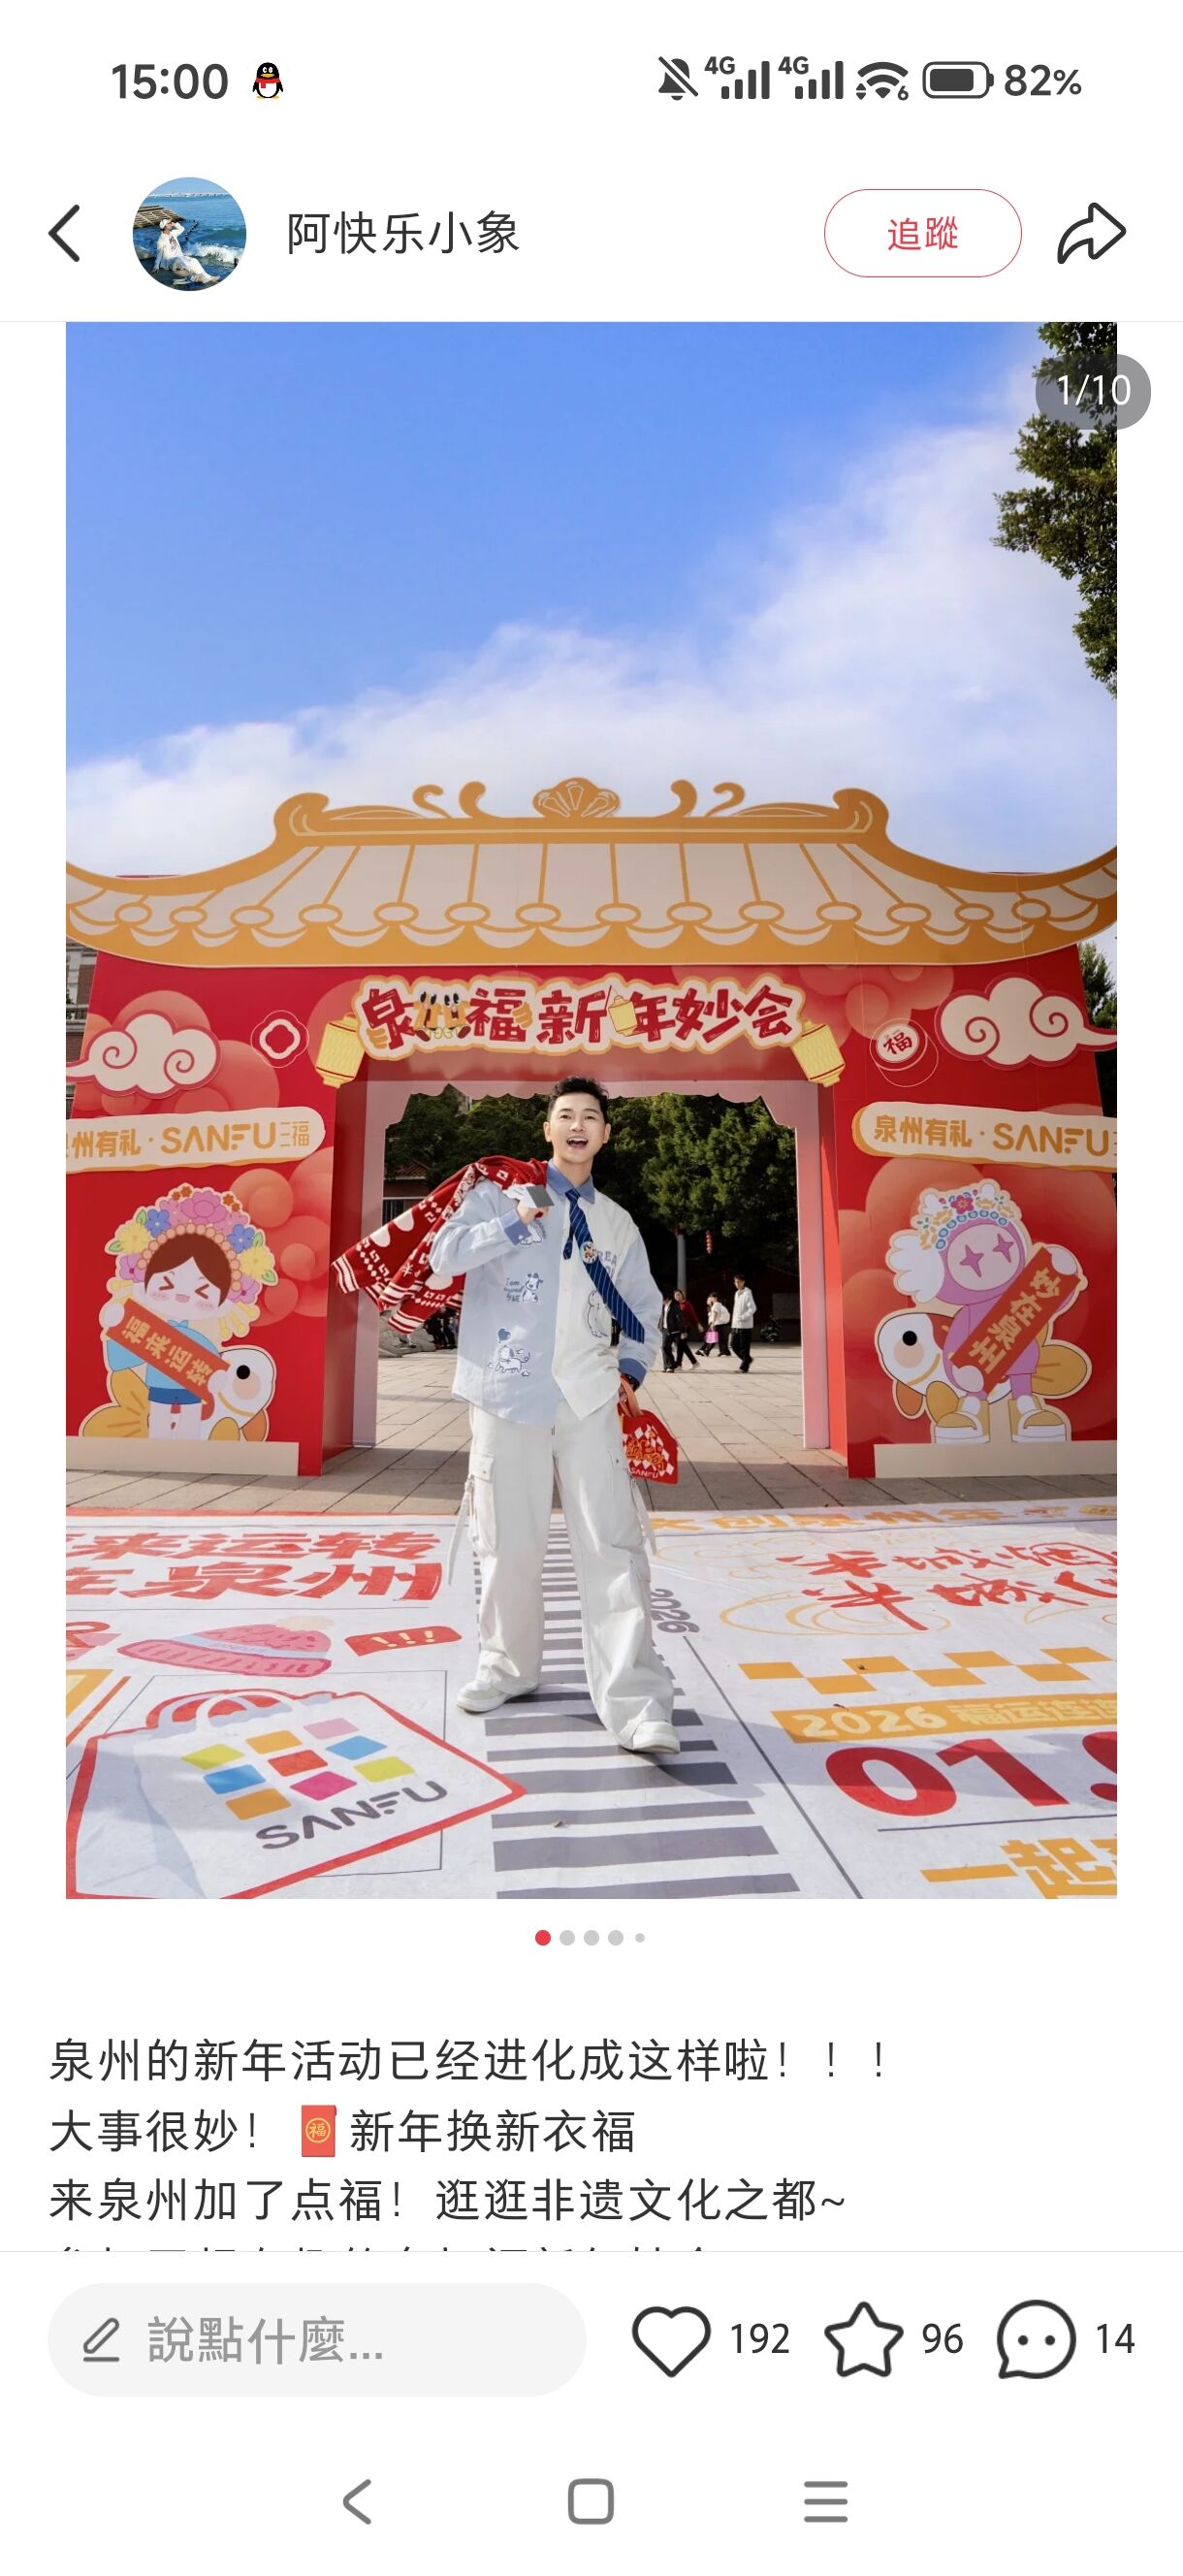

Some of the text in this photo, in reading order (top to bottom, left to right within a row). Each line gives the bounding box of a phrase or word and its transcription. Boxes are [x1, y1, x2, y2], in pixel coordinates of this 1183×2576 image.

[112, 64, 228, 99] 15:00
[704, 56, 736, 75] 4G
[778, 56, 810, 75] 4G
[1004, 64, 1082, 96] 82%
[288, 210, 520, 255] 阿快乐小象
[887, 216, 958, 251] 追蹤
[882, 1032, 912, 1054] 福
[66, 1128, 142, 1158] 州有礼
[160, 1121, 276, 1154] SANFU
[873, 1114, 973, 1148] 泉州有礼
[992, 1122, 1109, 1157] SANFU
[968, 1268, 1062, 1374] 妙在泉州
[121, 1315, 213, 1387] 福来运转
[66, 1532, 440, 1560] 来运转
[793, 1706, 947, 1738] 2026
[256, 1780, 448, 1850] SANFU
[920, 1837, 1117, 1898] 一起
[49, 2038, 881, 2082] 泉州的新年活动已经进化成这样啦！！！
[48, 2109, 255, 2153] 大事很妙！
[350, 2109, 635, 2153] 新年换新衣福
[731, 2323, 790, 2354] 192
[922, 2323, 964, 2354] 96
[1097, 2323, 1135, 2354] 14
